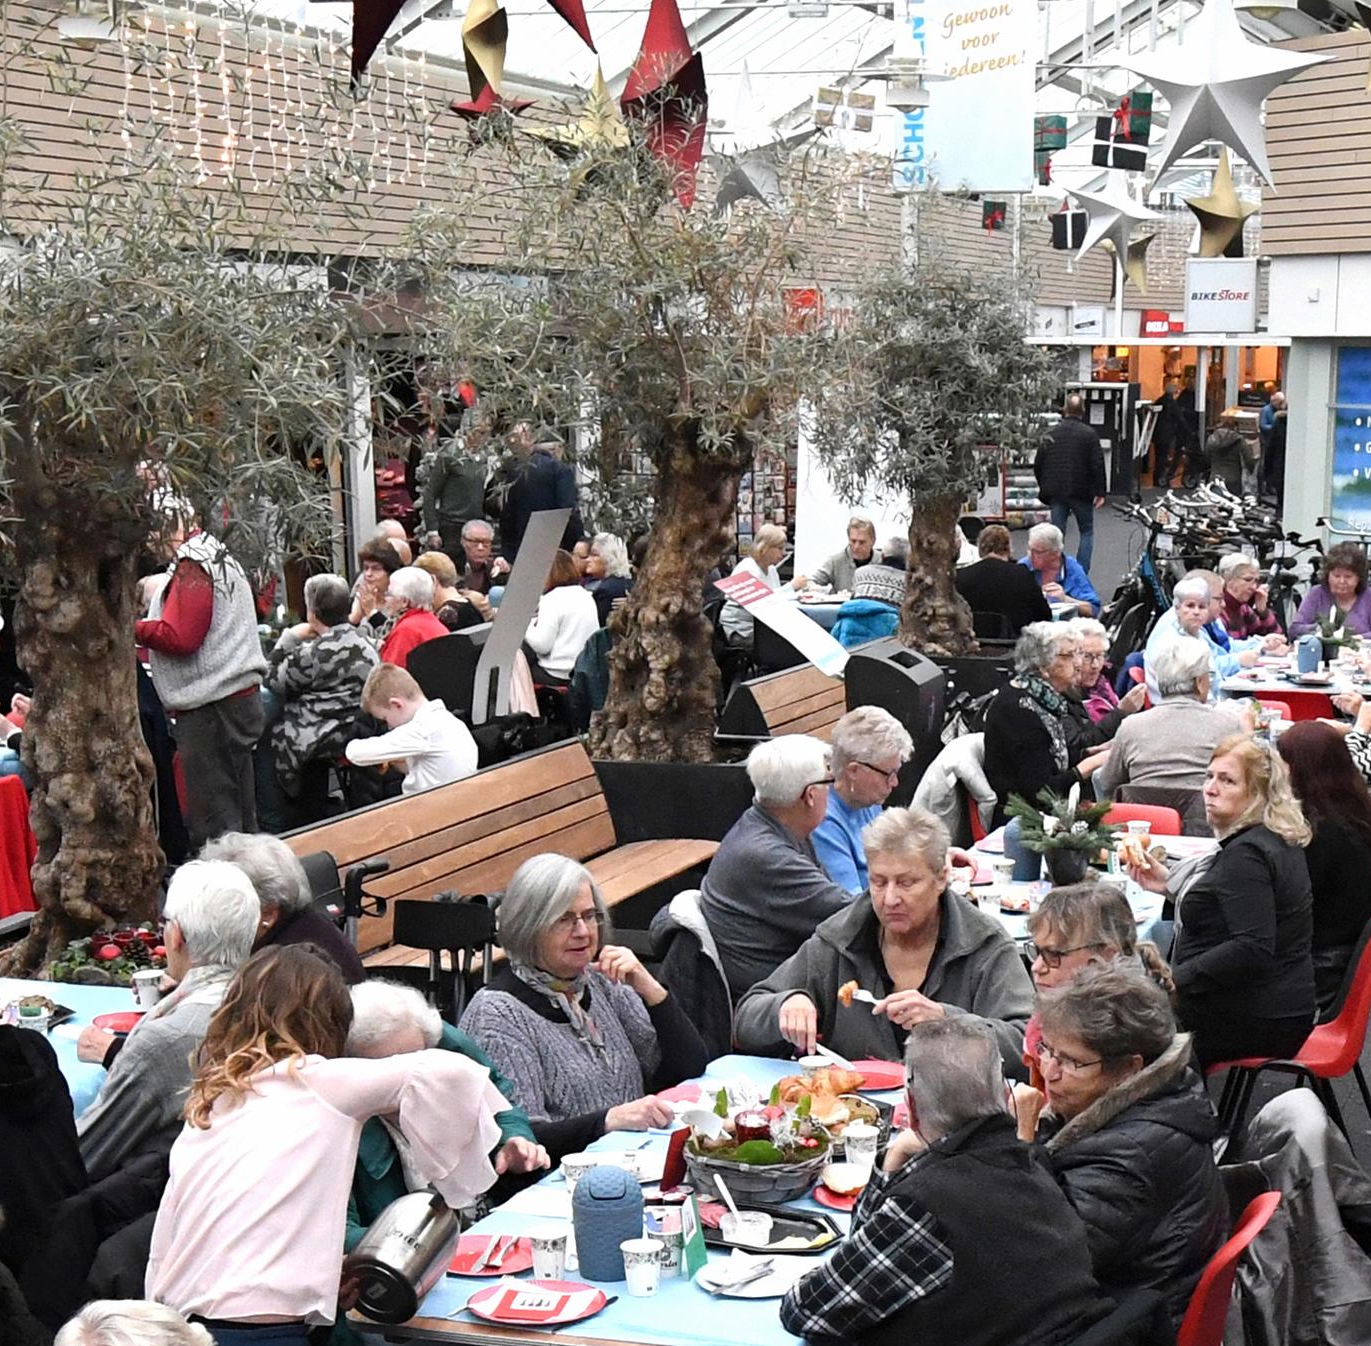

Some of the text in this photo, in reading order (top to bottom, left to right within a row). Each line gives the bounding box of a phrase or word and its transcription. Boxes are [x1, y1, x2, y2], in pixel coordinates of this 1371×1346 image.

[942, 1, 1013, 39] Gewoon
[962, 32, 1000, 50] voor
[943, 50, 1026, 79] iedereen!
[1191, 290, 1250, 301] BIKESTORE
